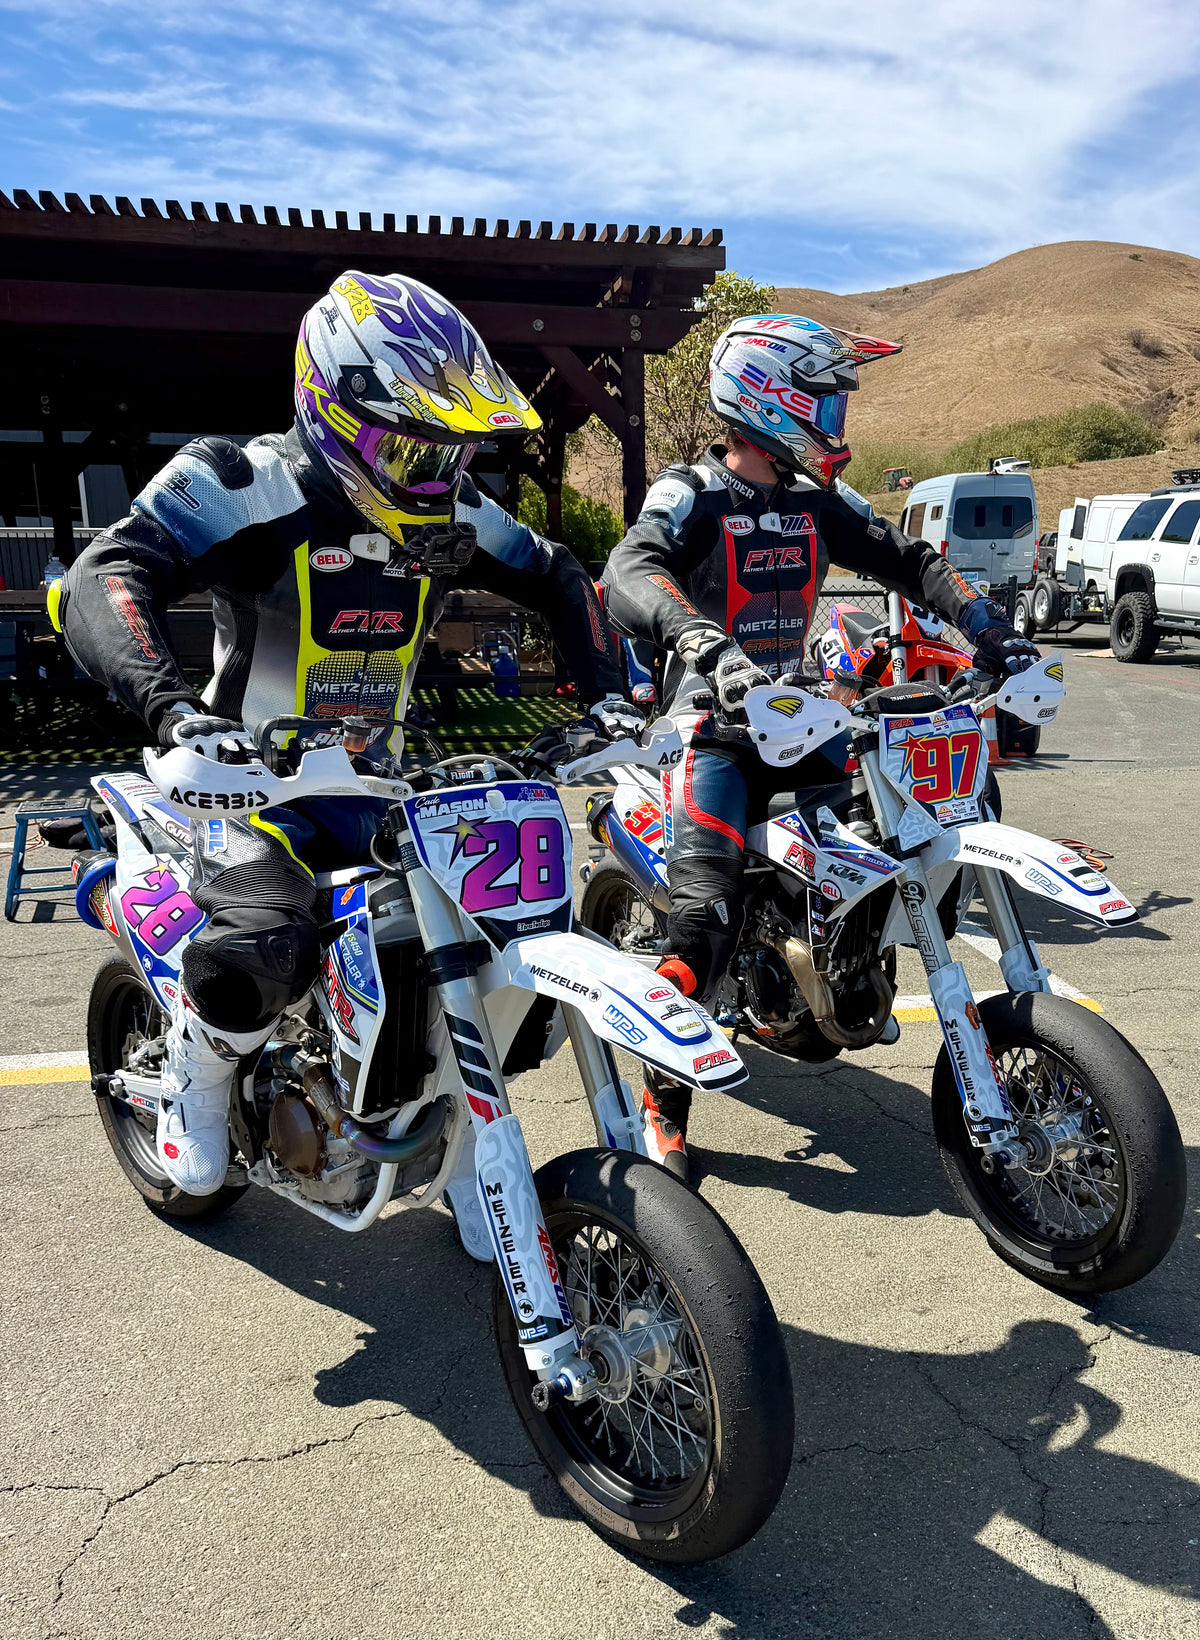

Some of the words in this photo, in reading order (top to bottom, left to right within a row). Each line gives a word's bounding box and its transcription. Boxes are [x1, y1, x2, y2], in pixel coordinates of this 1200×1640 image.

[333, 277, 378, 325] 328
[755, 318, 790, 330] 97
[744, 338, 788, 354] AMSOIL
[296, 338, 363, 444] EKS
[740, 362, 814, 418] EKS
[739, 395, 758, 411] BELL
[492, 414, 520, 425] BELL
[727, 521, 751, 530] BELL
[316, 554, 347, 565] BELL
[744, 546, 807, 569] FTR
[330, 610, 405, 632] FTR
[738, 618, 804, 633] METZELER
[312, 682, 397, 694] METZELER
[889, 718, 914, 730] EZRA
[451, 771, 475, 780] FLIGHT
[909, 730, 983, 805] 97
[169, 786, 270, 811] ACERBIS
[420, 798, 486, 820] MASON
[166, 823, 193, 845] GUTS
[785, 842, 816, 878] FTR
[963, 843, 1014, 863] METZELER
[1060, 855, 1078, 863] BELL
[459, 817, 566, 914] 28
[826, 863, 868, 886] KTM
[822, 884, 838, 899] BELL
[1024, 867, 1063, 896] WPS
[121, 870, 204, 956] 28
[1099, 900, 1132, 915] FTR
[529, 964, 590, 997] METZELER
[649, 989, 673, 1001] BELL
[602, 1004, 648, 1045] WPS
[693, 1050, 738, 1074] FTR
[945, 1019, 977, 1102] METZELER
[131, 1095, 156, 1110] AMSOIL
[971, 1124, 992, 1132] WPS
[485, 1182, 528, 1296] METZELER
[536, 1223, 574, 1326] AMSOIL
[518, 1323, 549, 1341] WPS
